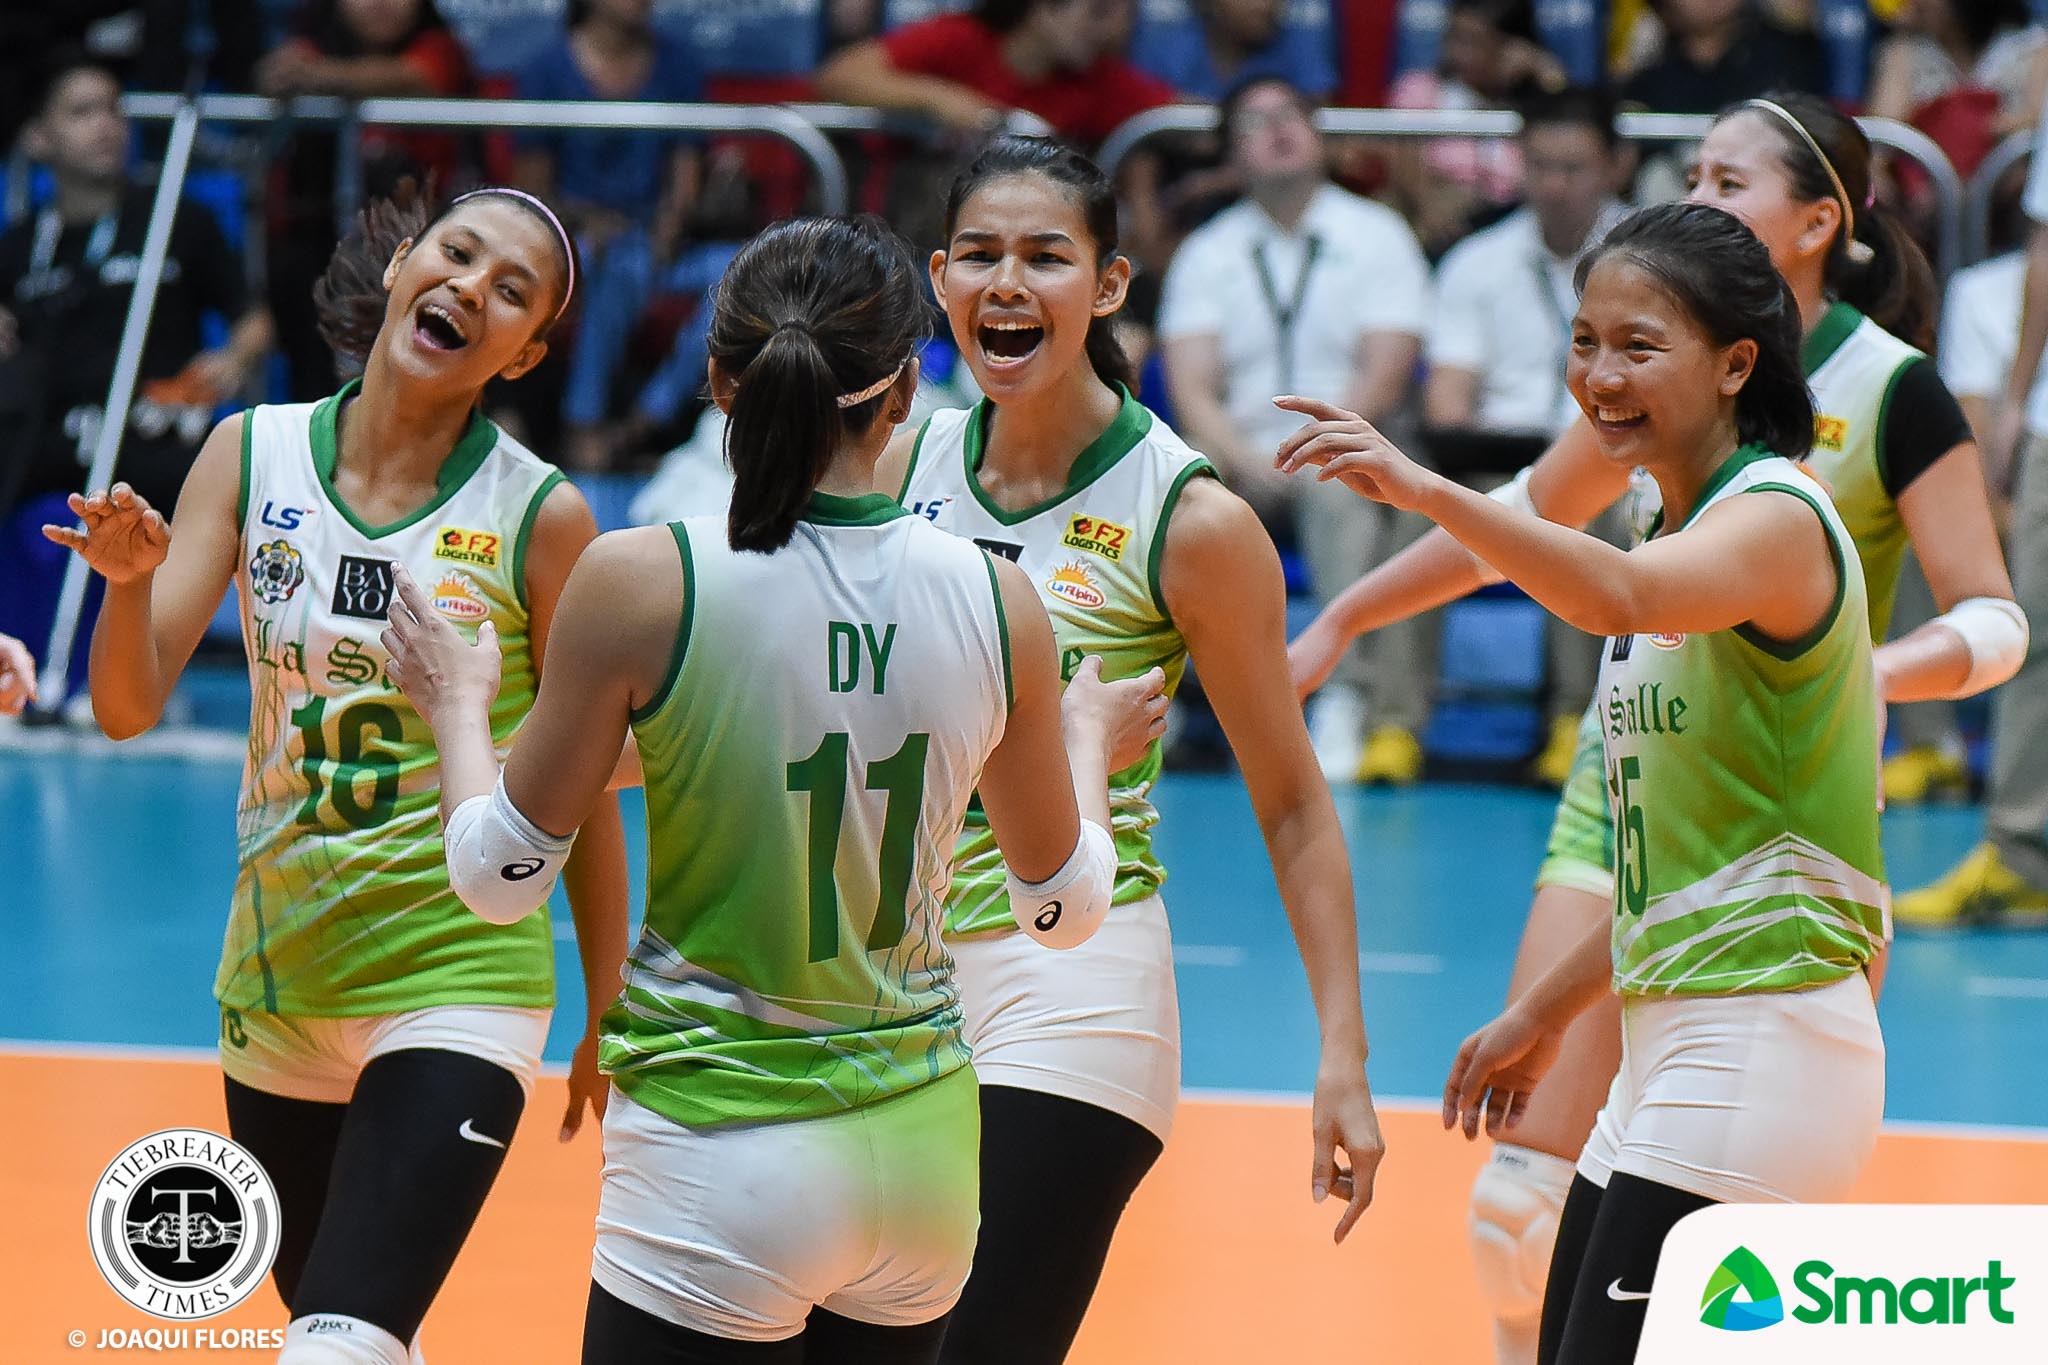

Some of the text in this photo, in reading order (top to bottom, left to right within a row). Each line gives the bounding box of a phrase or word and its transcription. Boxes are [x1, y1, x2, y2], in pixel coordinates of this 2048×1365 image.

[261, 501, 304, 530] LS
[468, 534, 497, 555] F2
[1064, 534, 1120, 559] LOGISTICS
[1094, 523, 1126, 549] F2
[436, 548, 495, 566] LOGISTICS
[1051, 582, 1099, 604] La Filipina
[828, 620, 897, 695] DY
[1608, 682, 1688, 740] Salle
[290, 695, 404, 830] 16
[787, 731, 930, 964] 11
